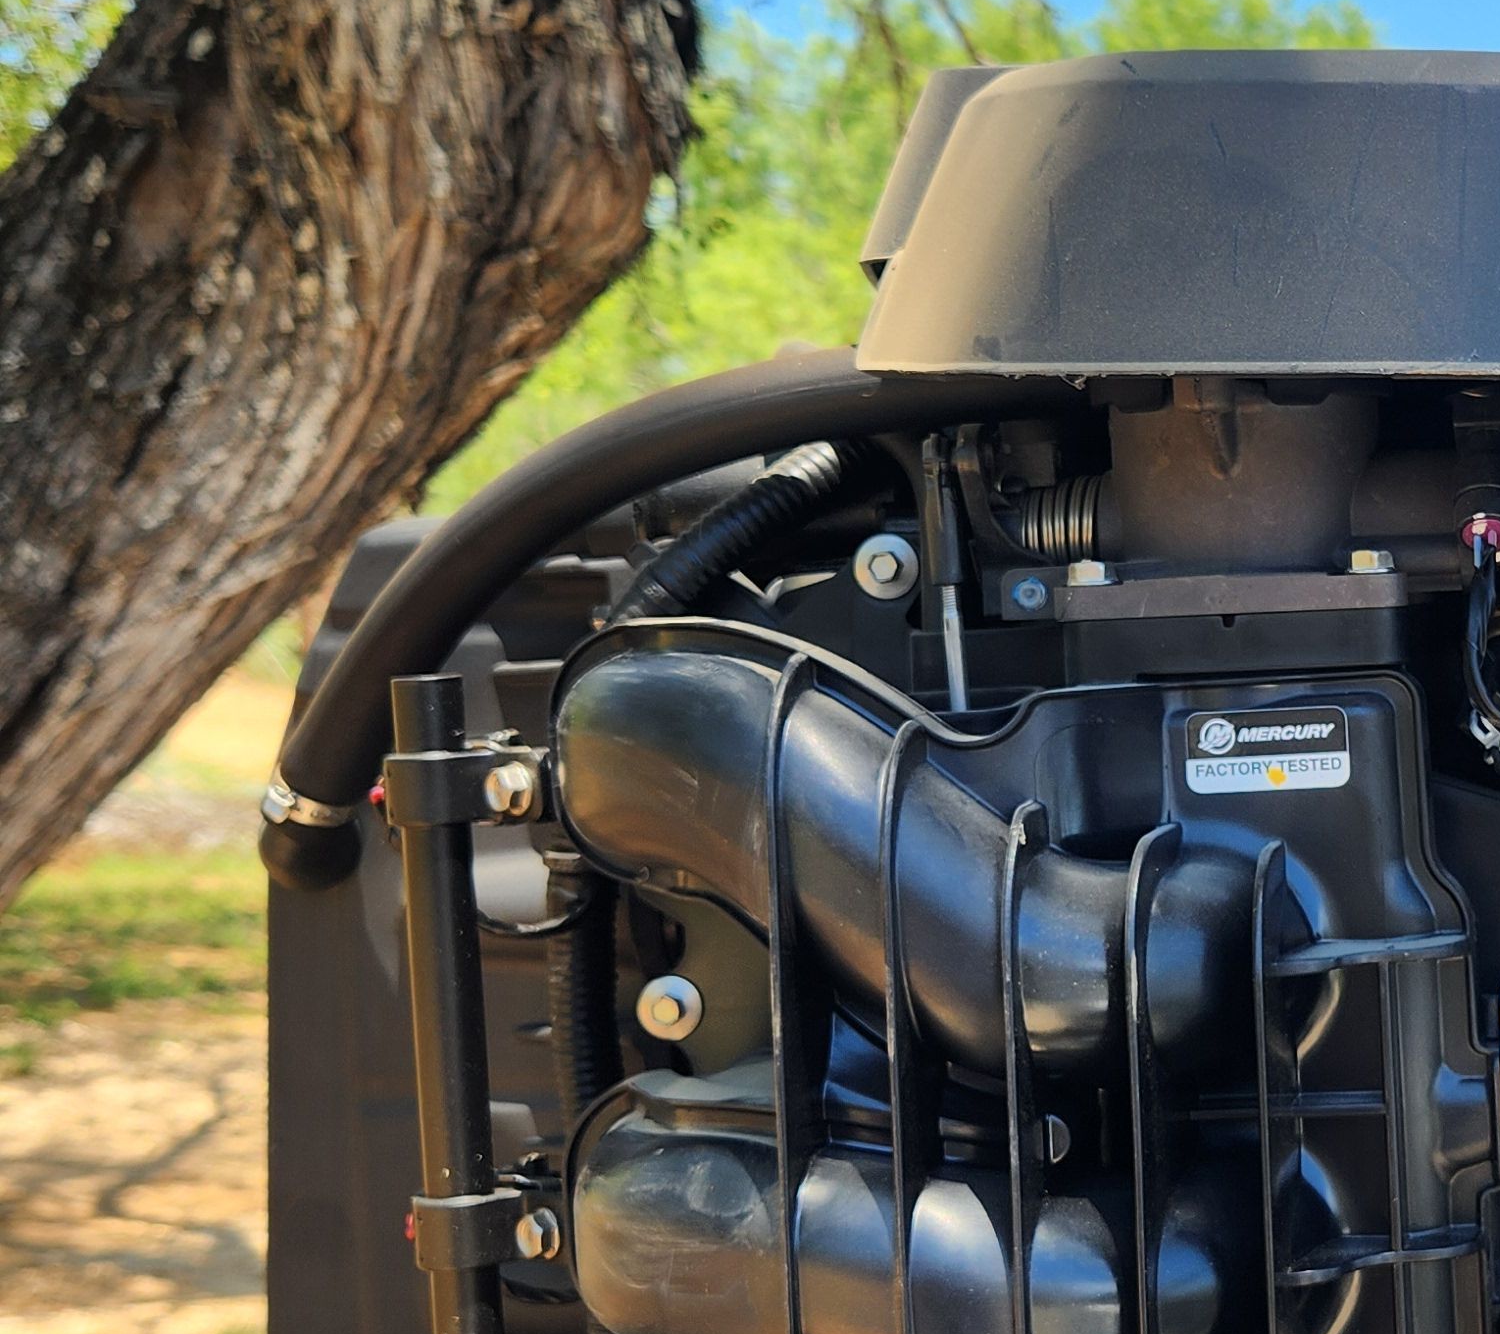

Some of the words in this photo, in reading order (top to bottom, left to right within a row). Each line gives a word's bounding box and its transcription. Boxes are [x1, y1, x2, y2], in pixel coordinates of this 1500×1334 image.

[1237, 723, 1335, 743] MERCURY
[1195, 761, 1272, 779] FACTORY
[1277, 757, 1342, 773] TESTED
